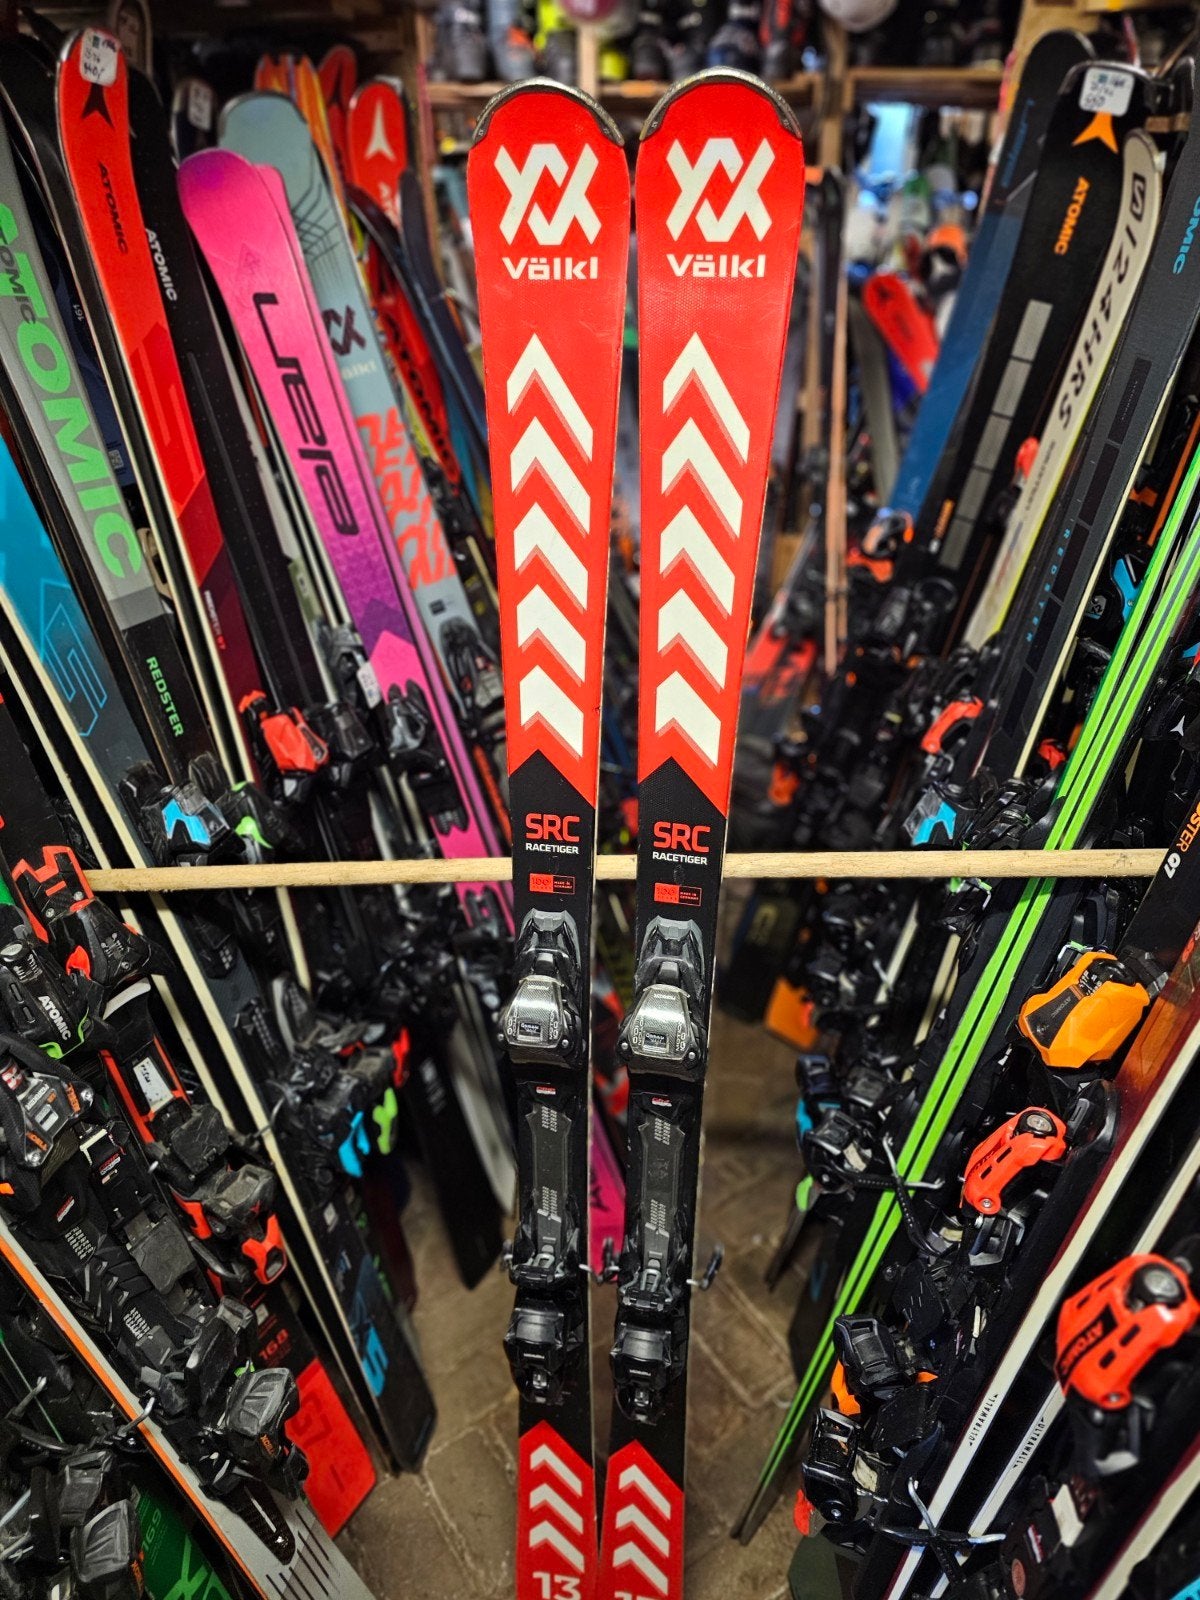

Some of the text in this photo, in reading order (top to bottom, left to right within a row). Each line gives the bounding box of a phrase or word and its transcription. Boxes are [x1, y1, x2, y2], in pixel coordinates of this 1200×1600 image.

[98, 161, 128, 255] ATOMIC
[1054, 176, 1090, 256] ATOMIC
[145, 228, 178, 301] ATOMIC
[501, 256, 599, 280] Völkl
[666, 253, 767, 278] Völkl
[146, 656, 184, 737] REDSTER
[525, 813, 580, 842] SRC
[525, 842, 579, 855] RACETIGER
[653, 821, 711, 853] SRC
[652, 851, 708, 866] RACETIGER
[38, 995, 72, 1040] ATOMIC
[969, 1397, 996, 1442] ULTRAWALL
[1016, 1422, 1046, 1464] ULTRAWALL
[142, 1508, 162, 1550] 169
[532, 1571, 581, 1600] 13
